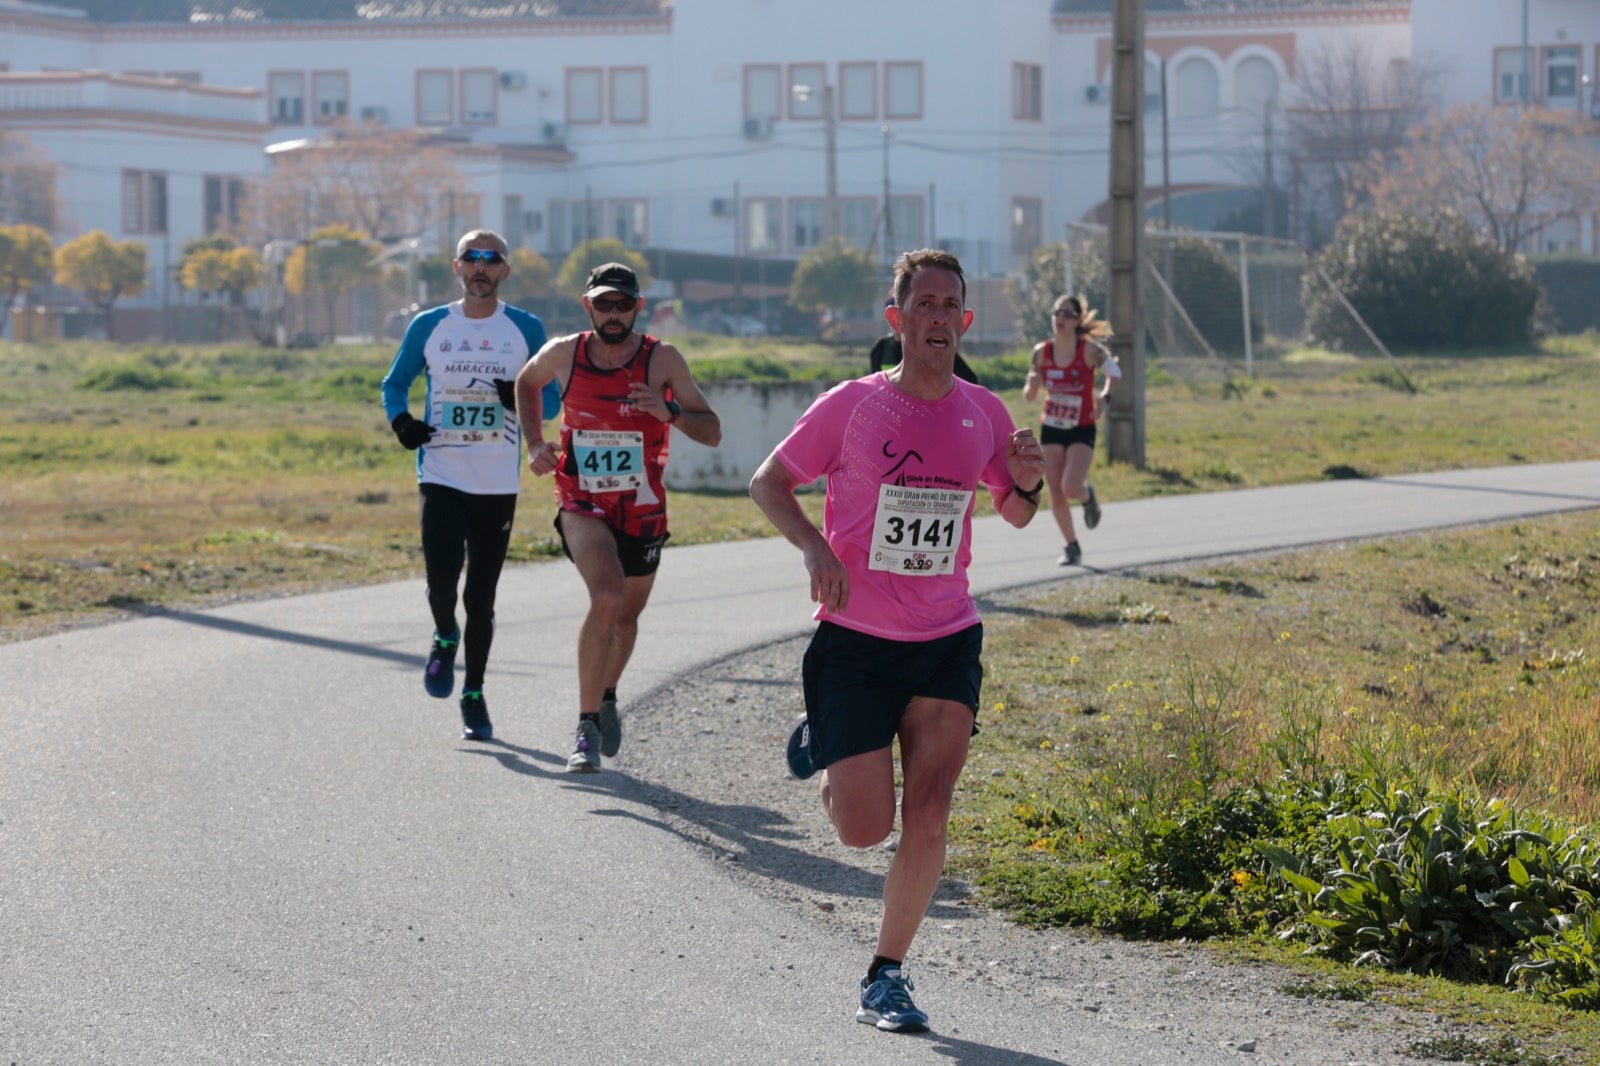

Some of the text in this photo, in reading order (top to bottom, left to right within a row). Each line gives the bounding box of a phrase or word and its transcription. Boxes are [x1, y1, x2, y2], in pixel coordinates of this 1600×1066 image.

[444, 364, 506, 375] MARACENA
[452, 406, 496, 427] 875
[1046, 400, 1078, 420] 2172
[584, 450, 631, 472] 412
[906, 475, 924, 483] Club
[924, 475, 933, 483] de
[904, 490, 921, 500] GRAN
[939, 493, 948, 502] DE
[885, 516, 955, 547] 3141
